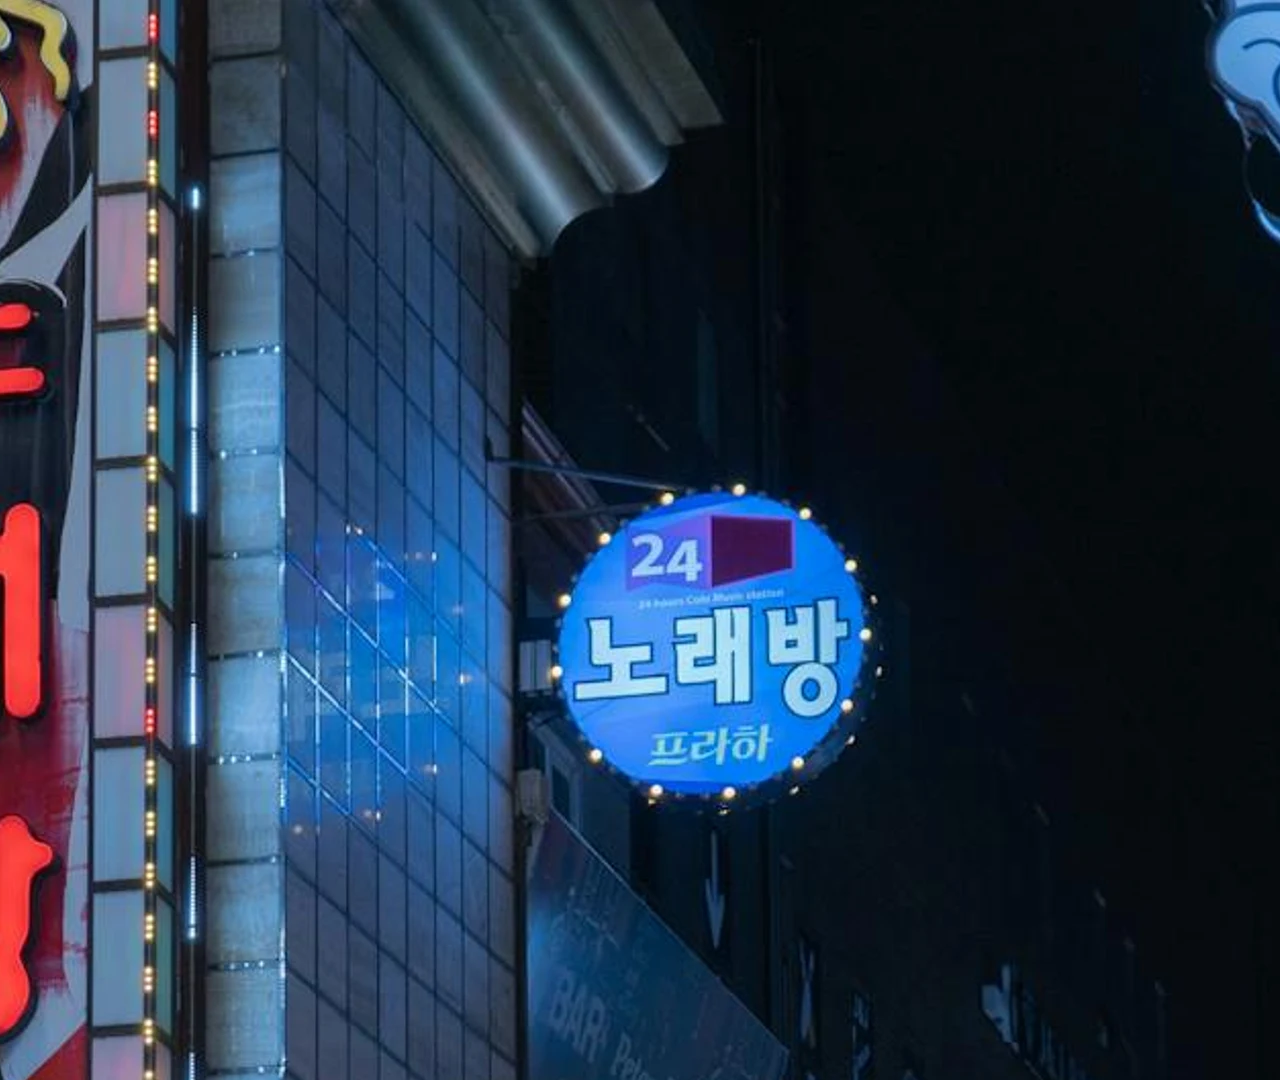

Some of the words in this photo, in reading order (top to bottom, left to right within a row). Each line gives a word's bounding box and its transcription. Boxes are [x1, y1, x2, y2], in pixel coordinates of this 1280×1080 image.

[630, 532, 702, 584] 24
[574, 598, 848, 718] 노래방
[648, 724, 773, 768] 프라하
[550, 974, 608, 1065] BAR
